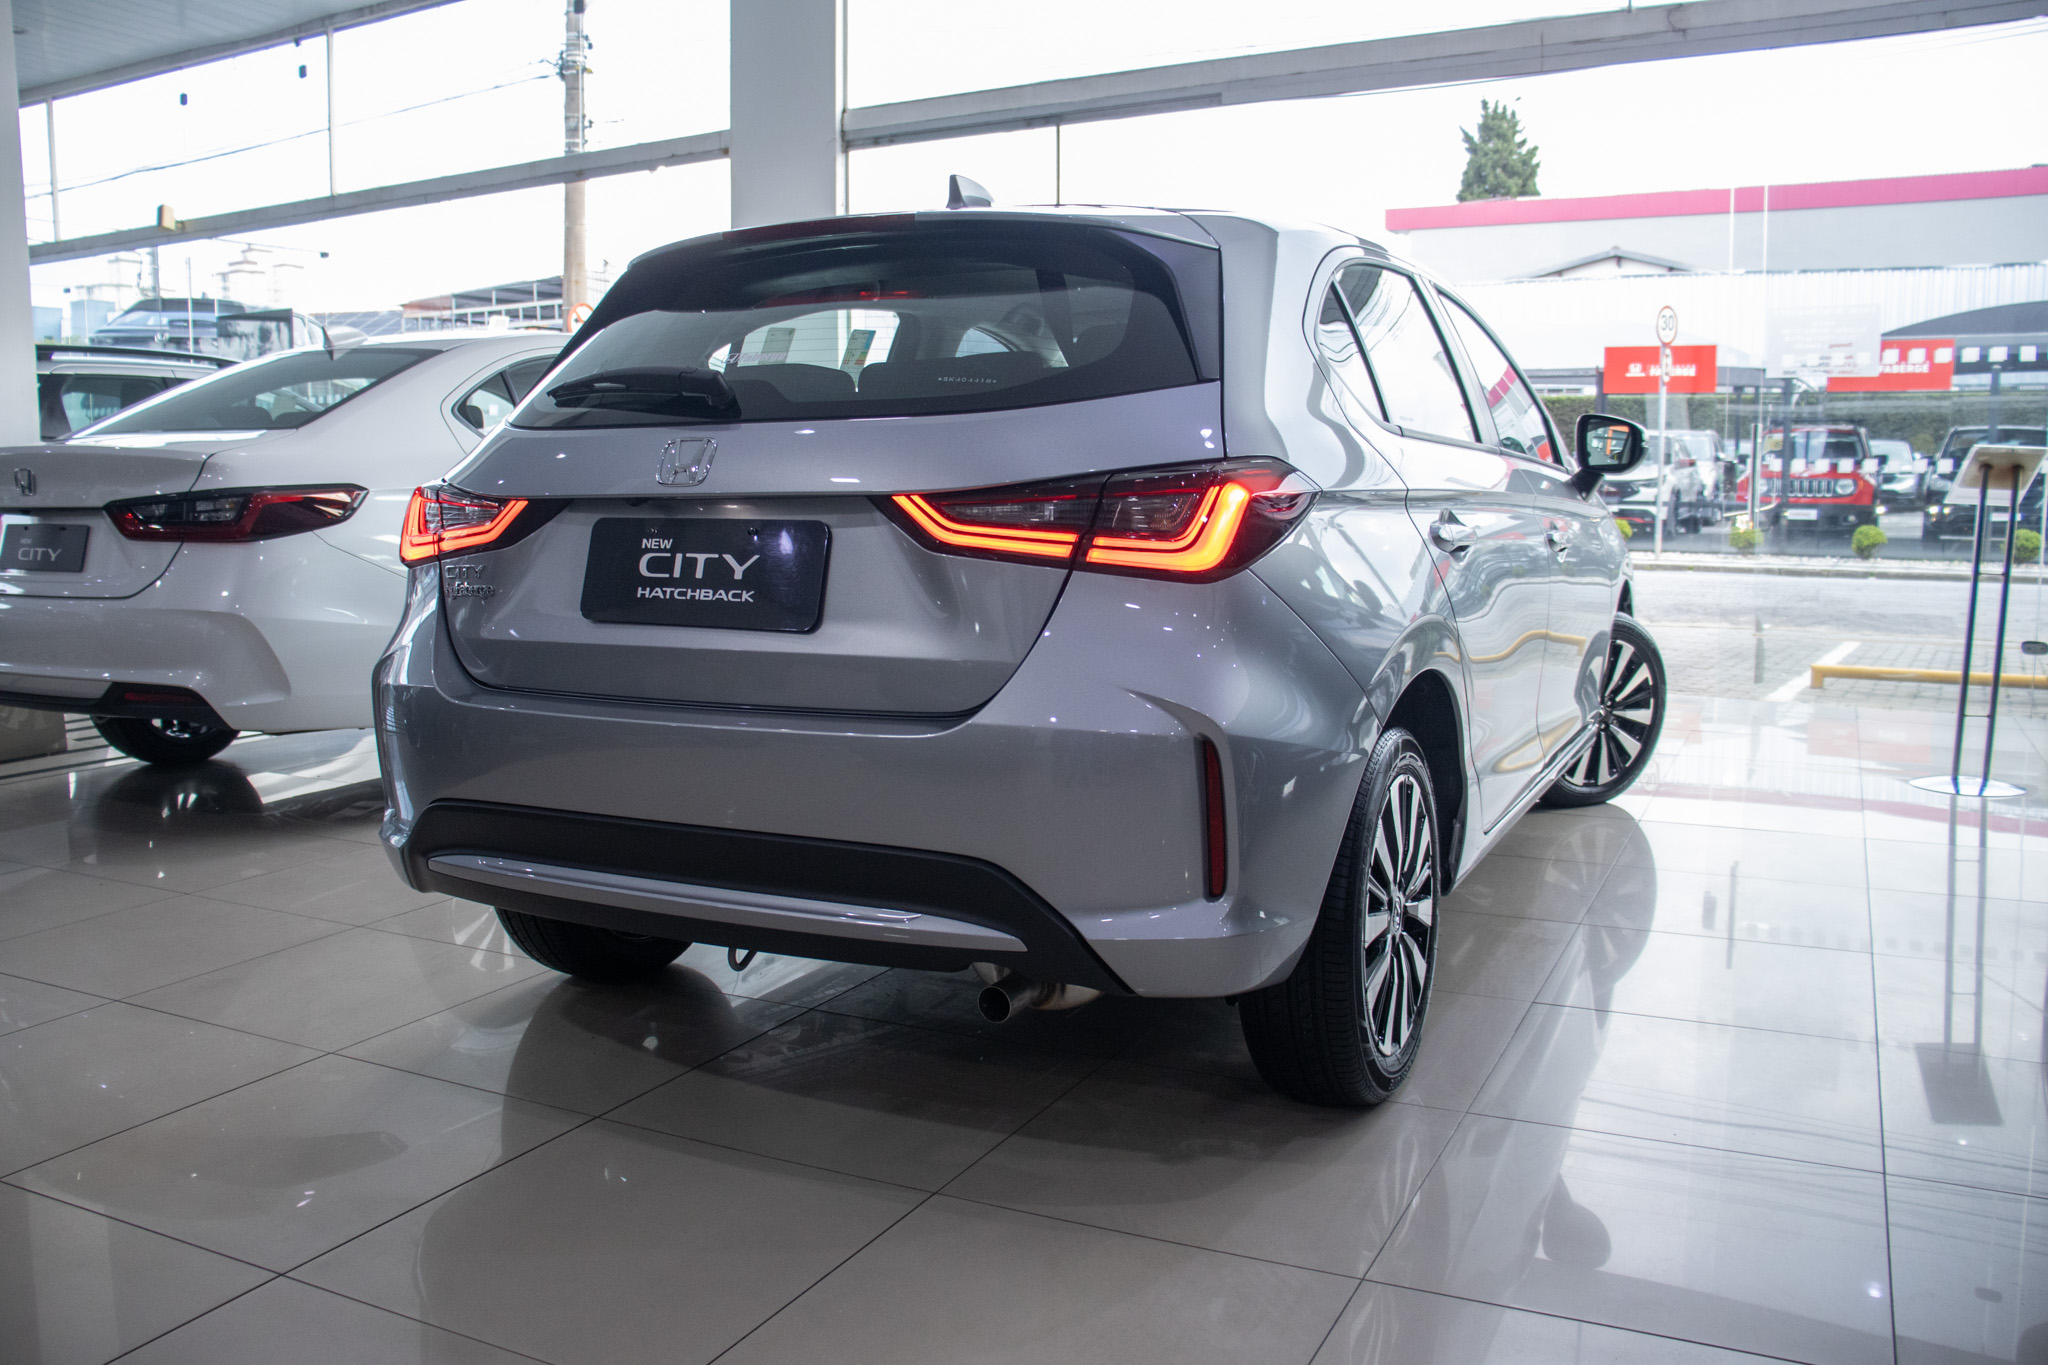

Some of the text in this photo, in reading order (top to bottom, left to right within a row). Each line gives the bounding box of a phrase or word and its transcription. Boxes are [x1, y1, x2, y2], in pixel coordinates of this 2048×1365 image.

[1661, 314, 1675, 331] 30
[641, 538, 673, 549] NEW
[18, 547, 62, 562] CITY
[445, 564, 484, 578] CITY
[638, 552, 760, 580] CITY
[637, 587, 755, 602] HATCHBACK
